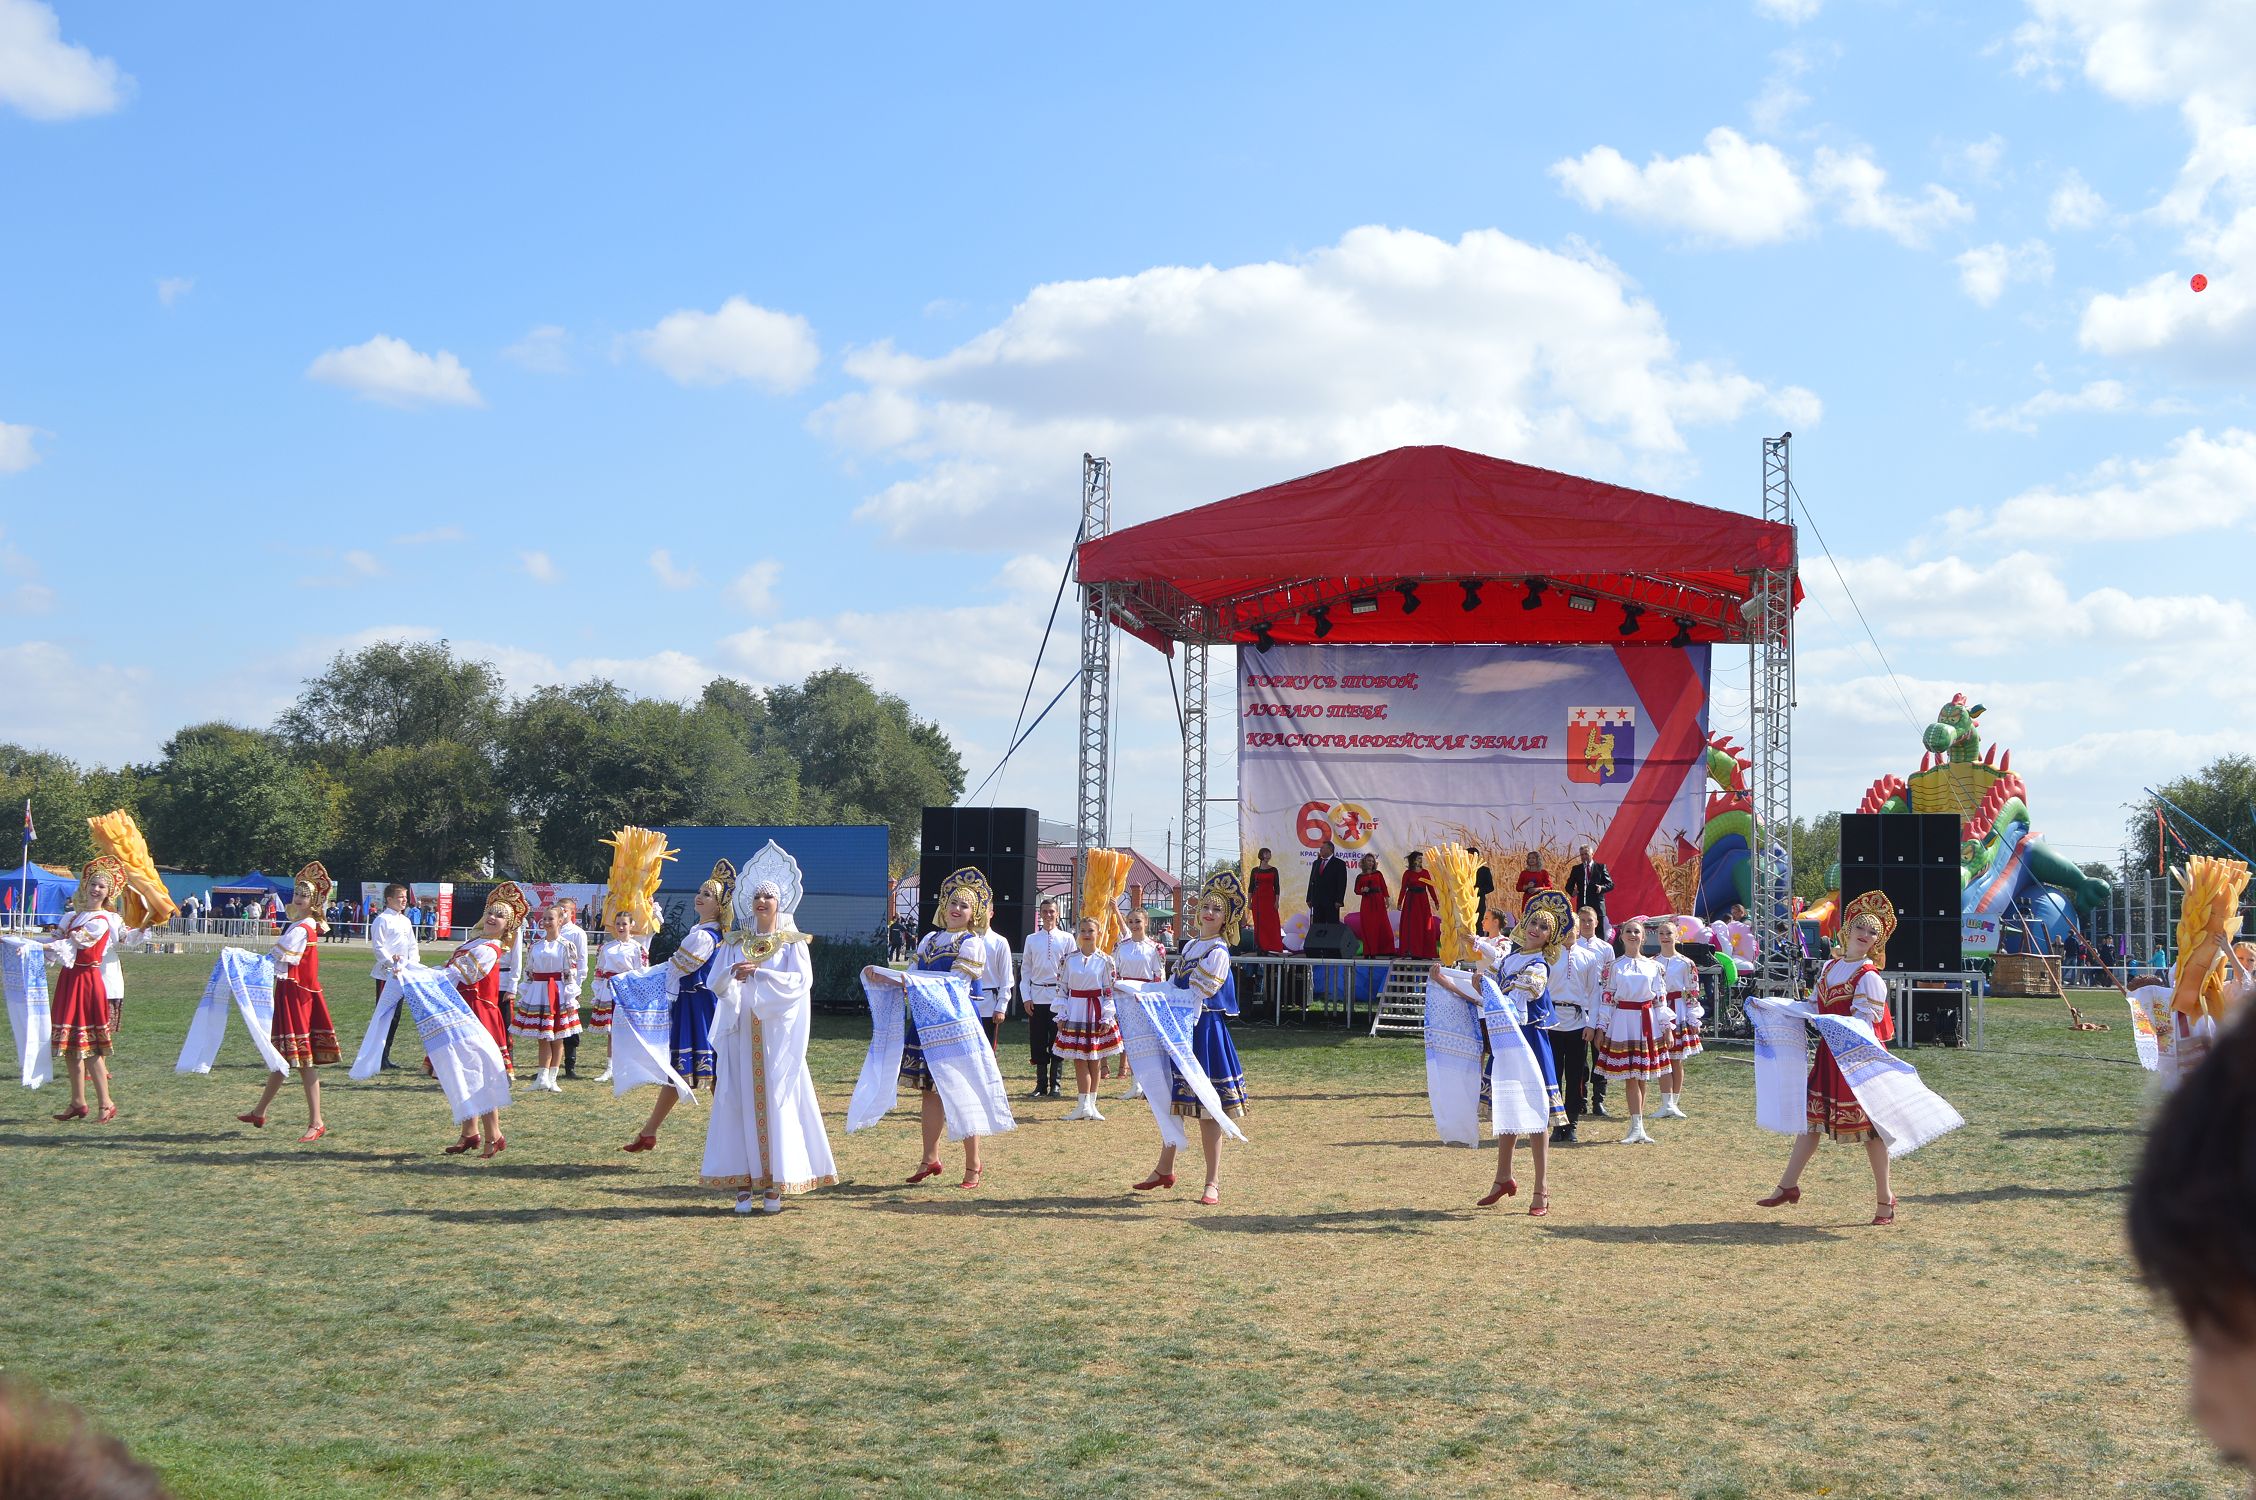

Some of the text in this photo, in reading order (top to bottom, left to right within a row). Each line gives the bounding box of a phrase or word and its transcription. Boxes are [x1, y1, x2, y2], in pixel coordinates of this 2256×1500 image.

[1247, 672, 1419, 690] ГОРЖУСЬ ТОБОЙ,
[1244, 703, 1388, 720] ЛЮБЛЮ ТЕБЯ,
[1246, 732, 1548, 751] КРАСНОГВАРДЕЙСКАЯ ЗЕМЛЯ!
[1359, 822, 1379, 830] лет
[1916, 1012, 1931, 1022] 32
